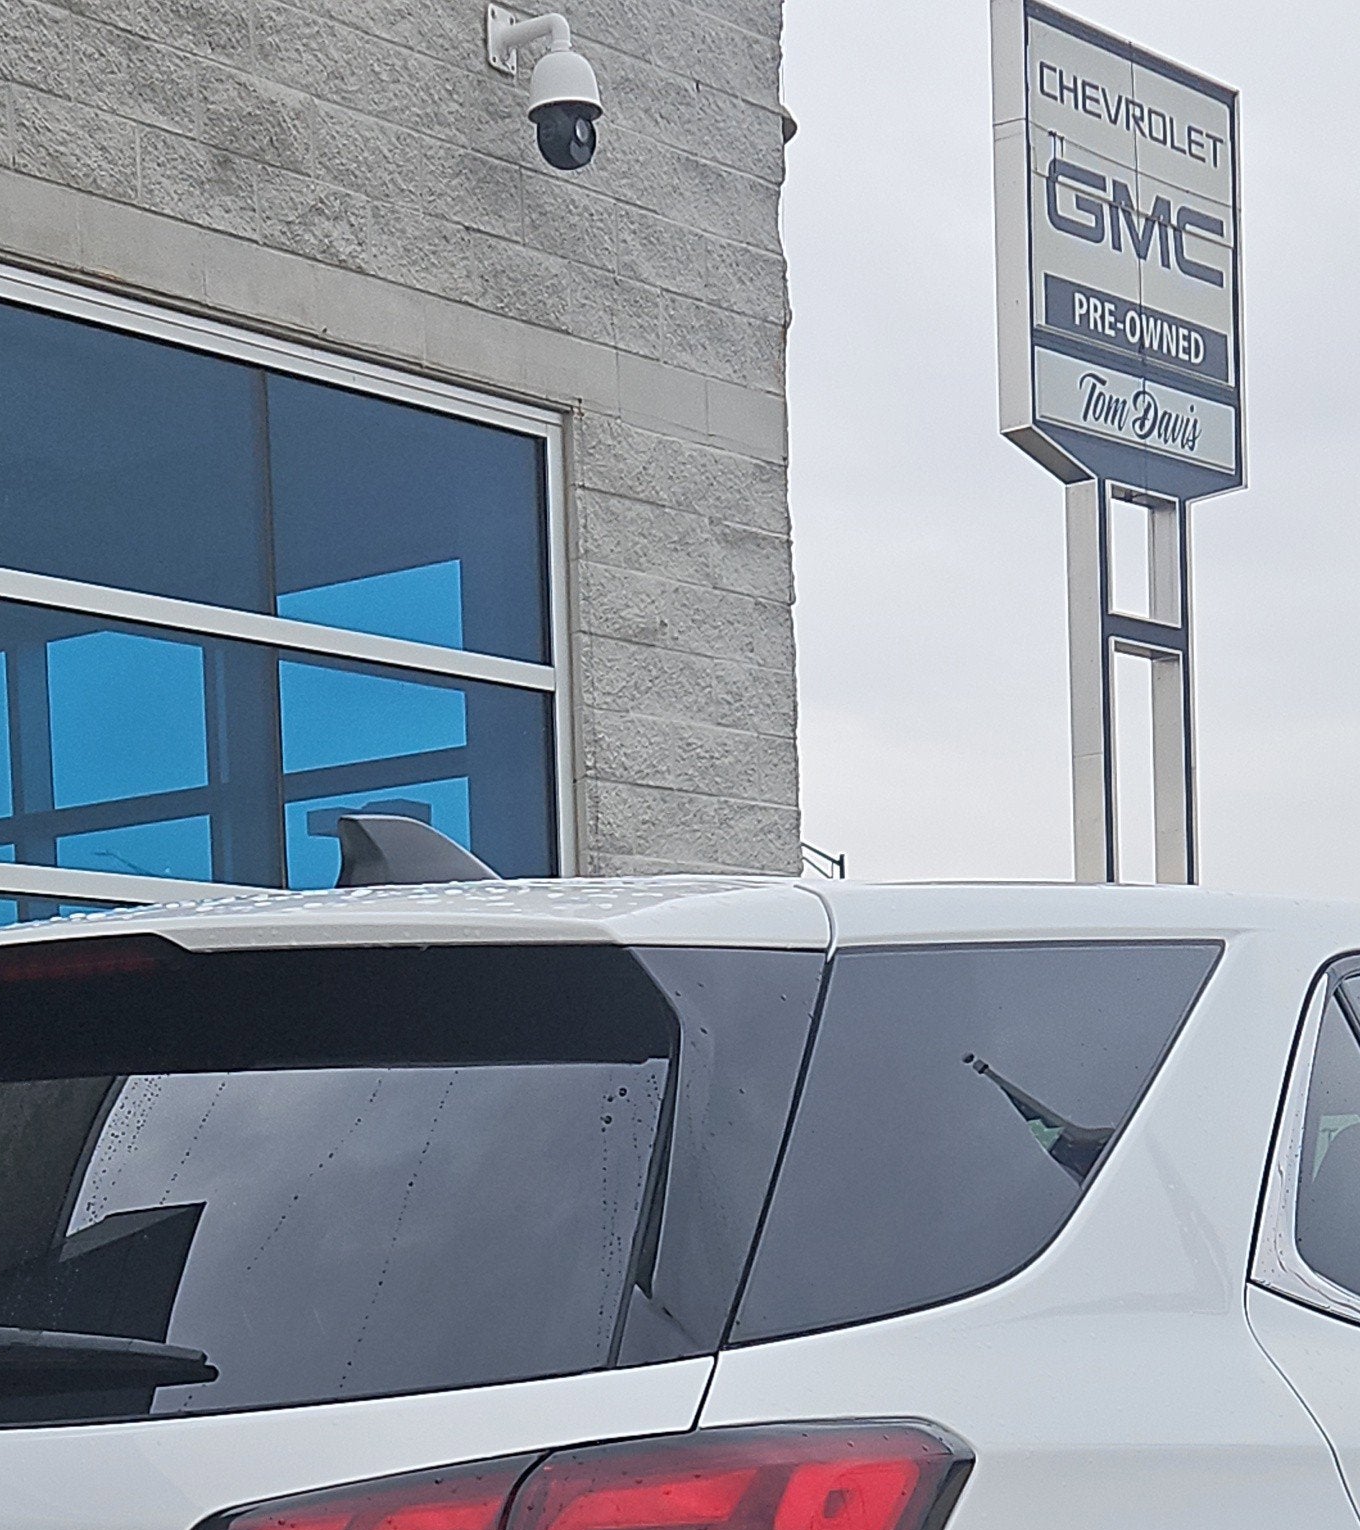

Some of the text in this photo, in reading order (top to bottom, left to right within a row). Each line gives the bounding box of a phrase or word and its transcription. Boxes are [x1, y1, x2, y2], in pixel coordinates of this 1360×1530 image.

[1038, 60, 1225, 169] CHEVROLET
[1045, 155, 1226, 290] GMC
[1072, 290, 1206, 367] PRE-OWNED
[1078, 371, 1203, 453] Tom Davis
